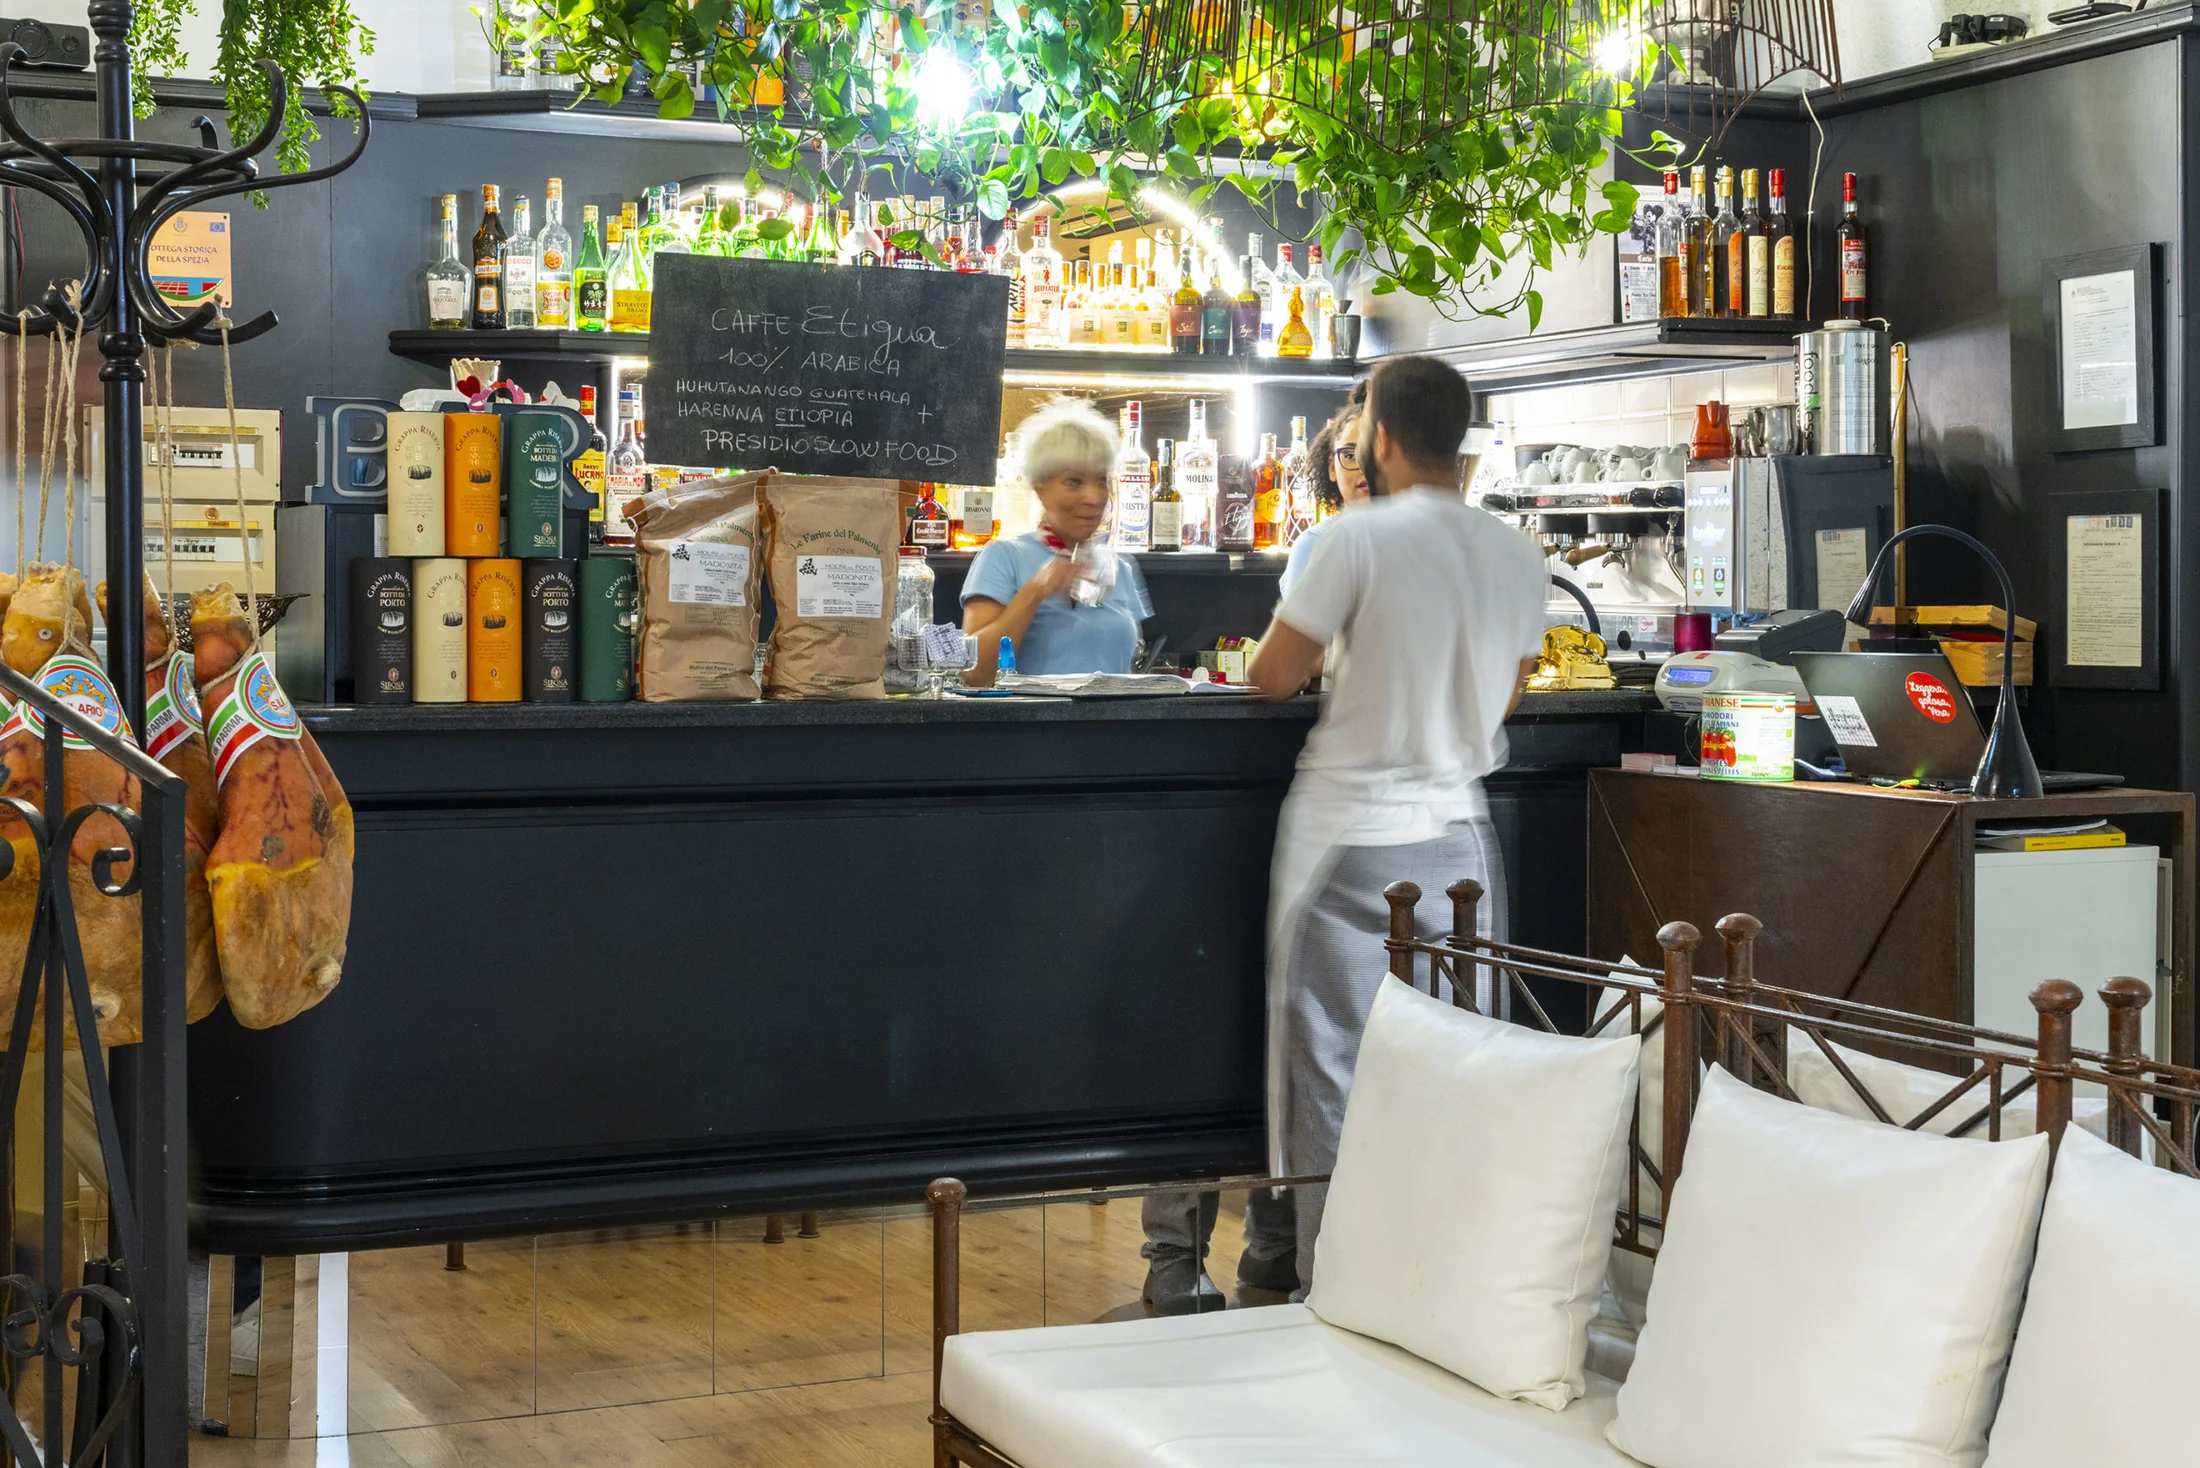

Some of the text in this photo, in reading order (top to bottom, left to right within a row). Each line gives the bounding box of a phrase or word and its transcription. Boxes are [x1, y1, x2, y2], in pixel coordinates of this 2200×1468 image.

[719, 346, 901, 377] 100% ARABICA
[676, 380, 911, 406] HUHUTANANGO GUATEMALA
[678, 402, 763, 423] HARENNA
[775, 406, 853, 427] ETIOPIA
[395, 425, 441, 452] GRAPPA RISERVA
[455, 428, 480, 452] GRAPPA
[521, 429, 546, 454] GRAPPA
[701, 429, 957, 467] PRESIDIO SLOW FOOD
[574, 467, 605, 480] LUCANO
[802, 530, 831, 544] Farine
[833, 529, 846, 538] del
[848, 530, 882, 555] Palmento
[699, 560, 743, 571] MADONITA
[827, 573, 875, 581] MADONITA
[367, 573, 393, 598] GRAPPA
[428, 575, 452, 599] GRAPPA
[471, 572, 517, 598] GRAPPA RISERVA
[531, 574, 556, 598] GRAPPA
[542, 590, 560, 598] BOTTI
[605, 575, 628, 599] GRAPPA
[380, 598, 405, 607] PORTO
[542, 598, 569, 607] PORTO
[146, 709, 175, 738] PARMA
[216, 714, 244, 746] PARMA
